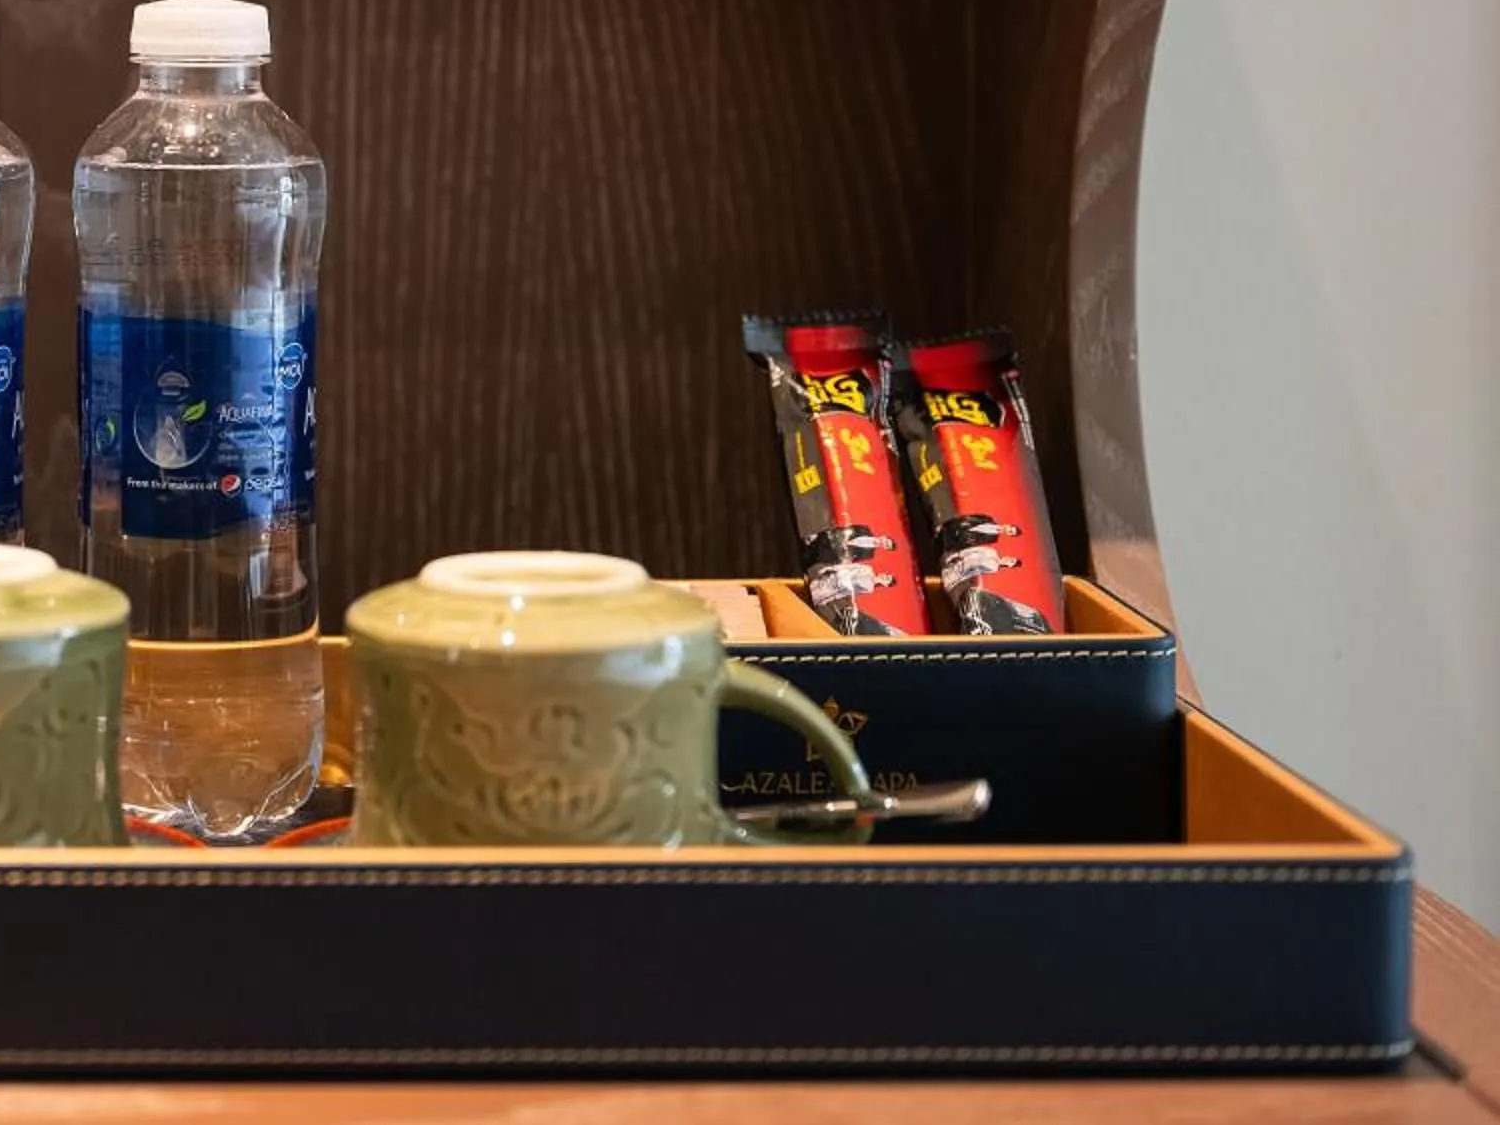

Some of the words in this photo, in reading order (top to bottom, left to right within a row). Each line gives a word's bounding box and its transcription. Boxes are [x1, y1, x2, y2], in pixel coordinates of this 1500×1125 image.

[126, 476, 149, 489] From
[168, 479, 205, 492] makers
[205, 480, 217, 492] of
[722, 770, 837, 795] AZALE
[872, 771, 919, 793] APA
